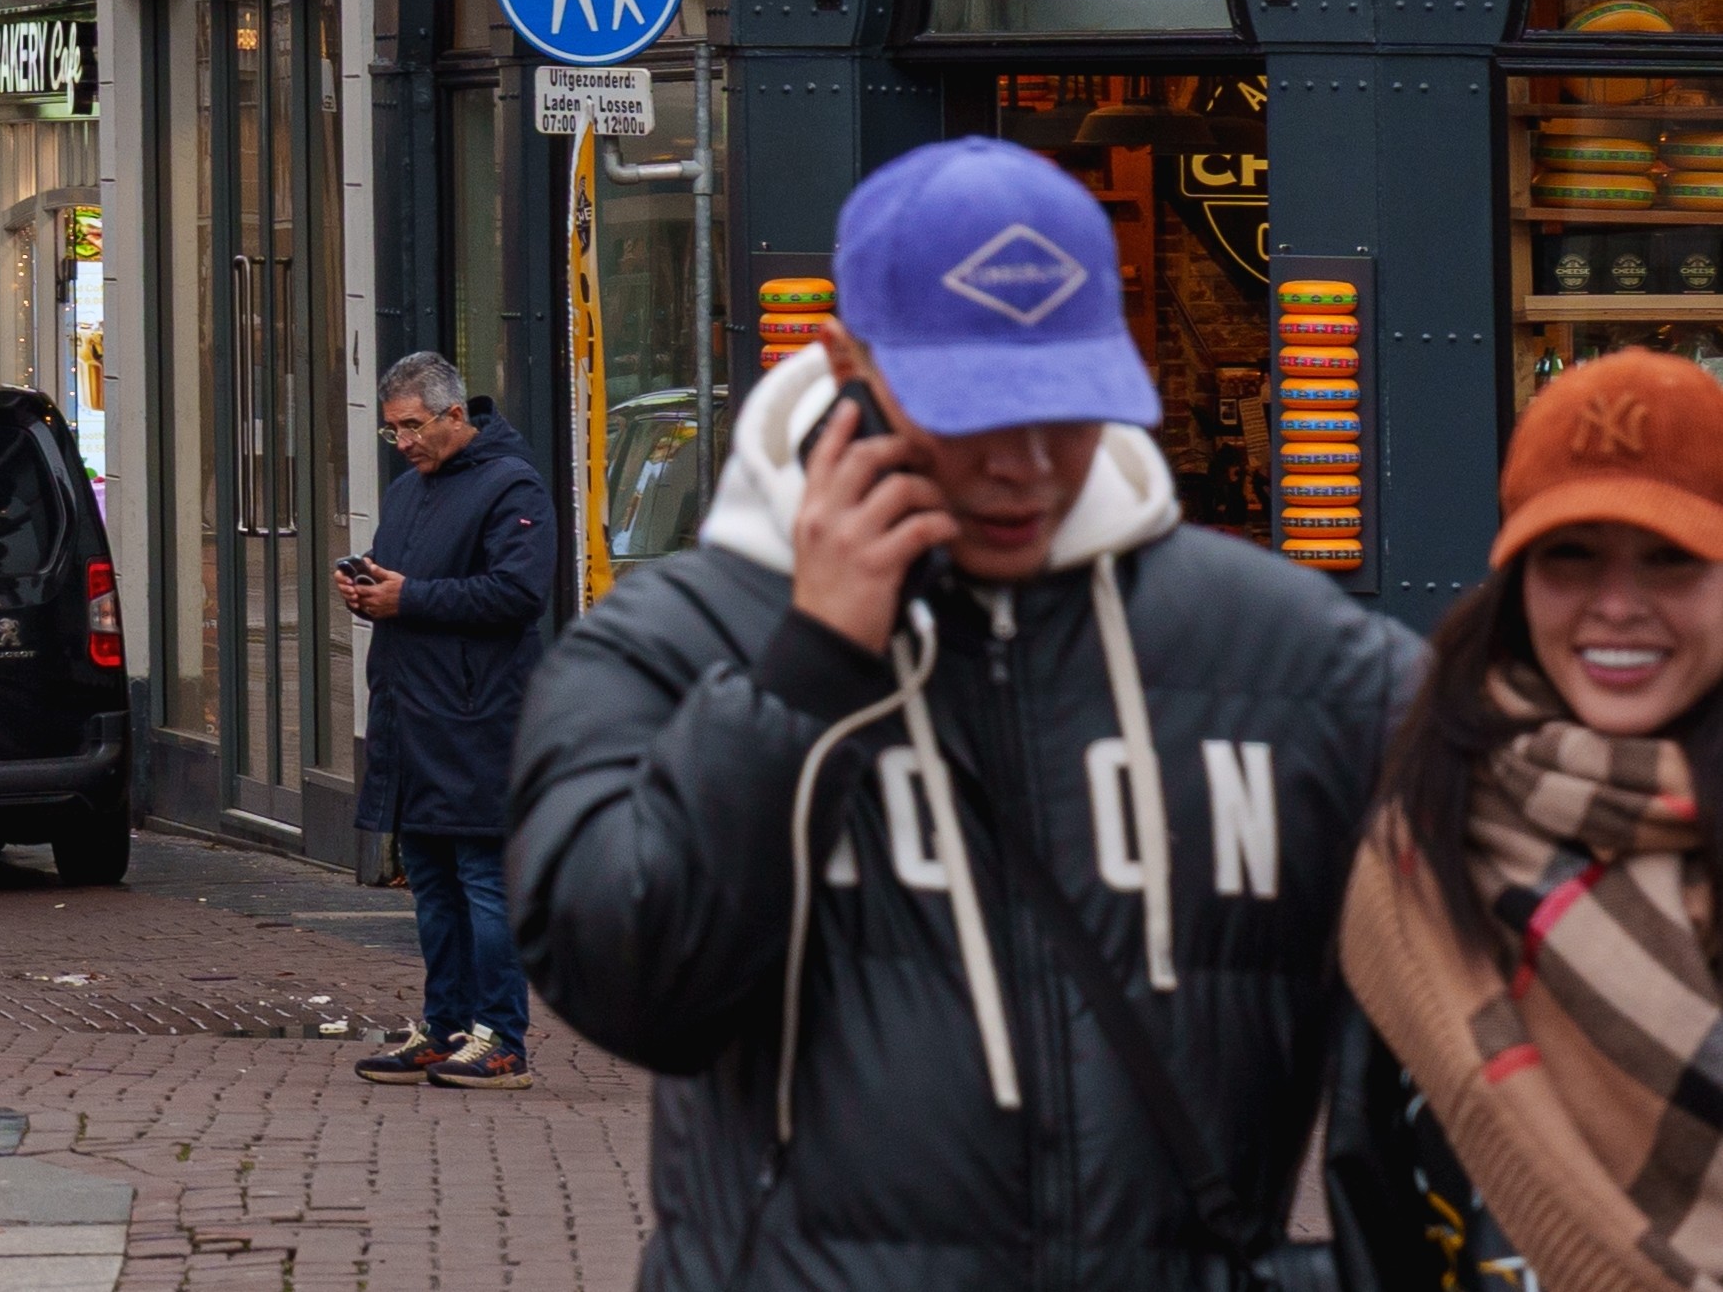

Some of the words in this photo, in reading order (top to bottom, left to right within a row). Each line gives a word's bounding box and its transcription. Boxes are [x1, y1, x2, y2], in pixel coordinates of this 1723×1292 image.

[550, 69, 636, 91] Uitgezonderd:
[544, 94, 581, 111] Laden
[599, 95, 643, 114] Lossen
[542, 114, 577, 132] 07:00
[603, 116, 645, 134] 12:00u
